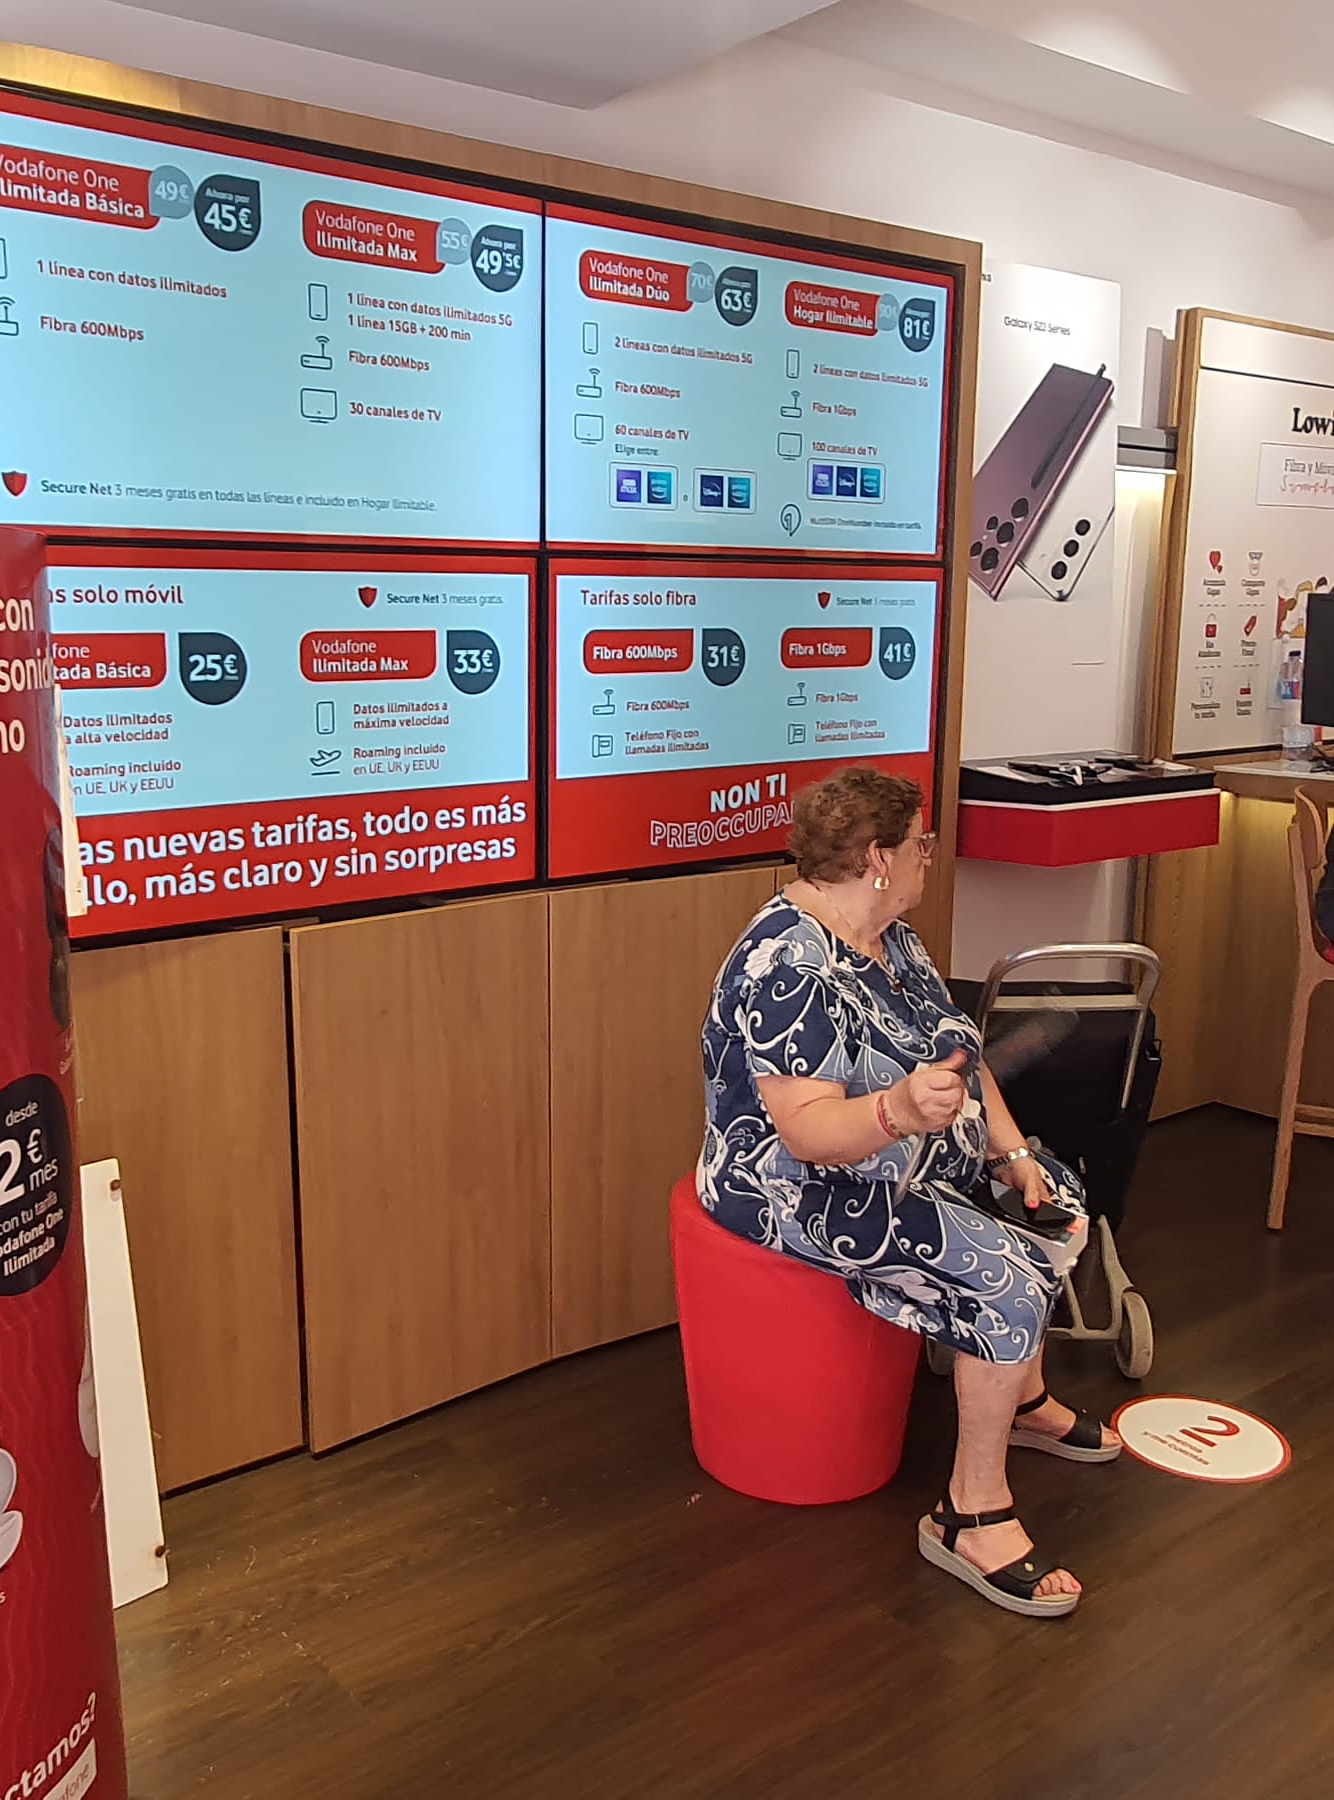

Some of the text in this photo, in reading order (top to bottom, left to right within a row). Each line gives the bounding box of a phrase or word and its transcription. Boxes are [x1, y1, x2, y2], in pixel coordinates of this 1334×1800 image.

[83, 169, 120, 192] One
[85, 190, 145, 219] Básica
[203, 202, 254, 233] 45€
[315, 210, 415, 242] Vodafone One
[316, 231, 417, 263] Ilimitada Max
[37, 259, 227, 298] 1 línea con datos ilimitados
[589, 257, 669, 284] Vodafone One
[589, 276, 670, 301] Ilimitada Dúo
[793, 289, 860, 310] Vodafone One
[357, 294, 513, 326] línea con datos ilimitados 5G
[721, 289, 753, 312] 63€
[794, 305, 824, 323] Hogar
[40, 316, 144, 342] Fibra 600Mbps
[357, 315, 385, 331] línea
[389, 319, 417, 334] 15GB
[428, 326, 448, 338] 200
[451, 328, 471, 341] min
[903, 317, 931, 338] 81€
[348, 350, 429, 372] Fibra 600Mbps
[349, 402, 442, 422] 30 canales de TV
[665, 429, 676, 439] de
[678, 430, 689, 440] TV
[41, 479, 86, 494] Secure
[90, 483, 112, 495] Net
[126, 487, 163, 499] meses
[73, 584, 183, 604] solo móvil
[580, 590, 696, 606] Tarifas solo fibra
[312, 639, 377, 654] Vodafone
[593, 646, 678, 661] Fibra 600Mbps
[707, 645, 740, 668] 31€
[883, 643, 912, 662] 41€
[95, 661, 152, 679] Básica
[188, 654, 239, 682] 25€
[312, 656, 409, 673] Ilimitada Max
[453, 649, 494, 674] 33€
[353, 701, 440, 715] Datos ilimitados
[63, 712, 173, 728] Datos ilimitados
[353, 715, 449, 729] máxima velocidad
[75, 728, 169, 744] alta velocidad
[353, 743, 446, 759] Roaming incluido
[129, 760, 182, 774] incluido
[109, 777, 174, 795] UK y EEUU
[710, 773, 786, 813] NON TI
[123, 795, 526, 861] nuevas tarifas, todo es más
[650, 801, 796, 848] PREOCCUPA
[145, 836, 516, 899] más claro y sin sorpresas
[4, 1100, 39, 1127] desde
[28, 1157, 59, 1192] mes
[21, 1208, 34, 1225] tu
[46, 1208, 65, 1229] One
[3, 1235, 56, 1277] Ilimitada
[1179, 1415, 1240, 1448] 2
